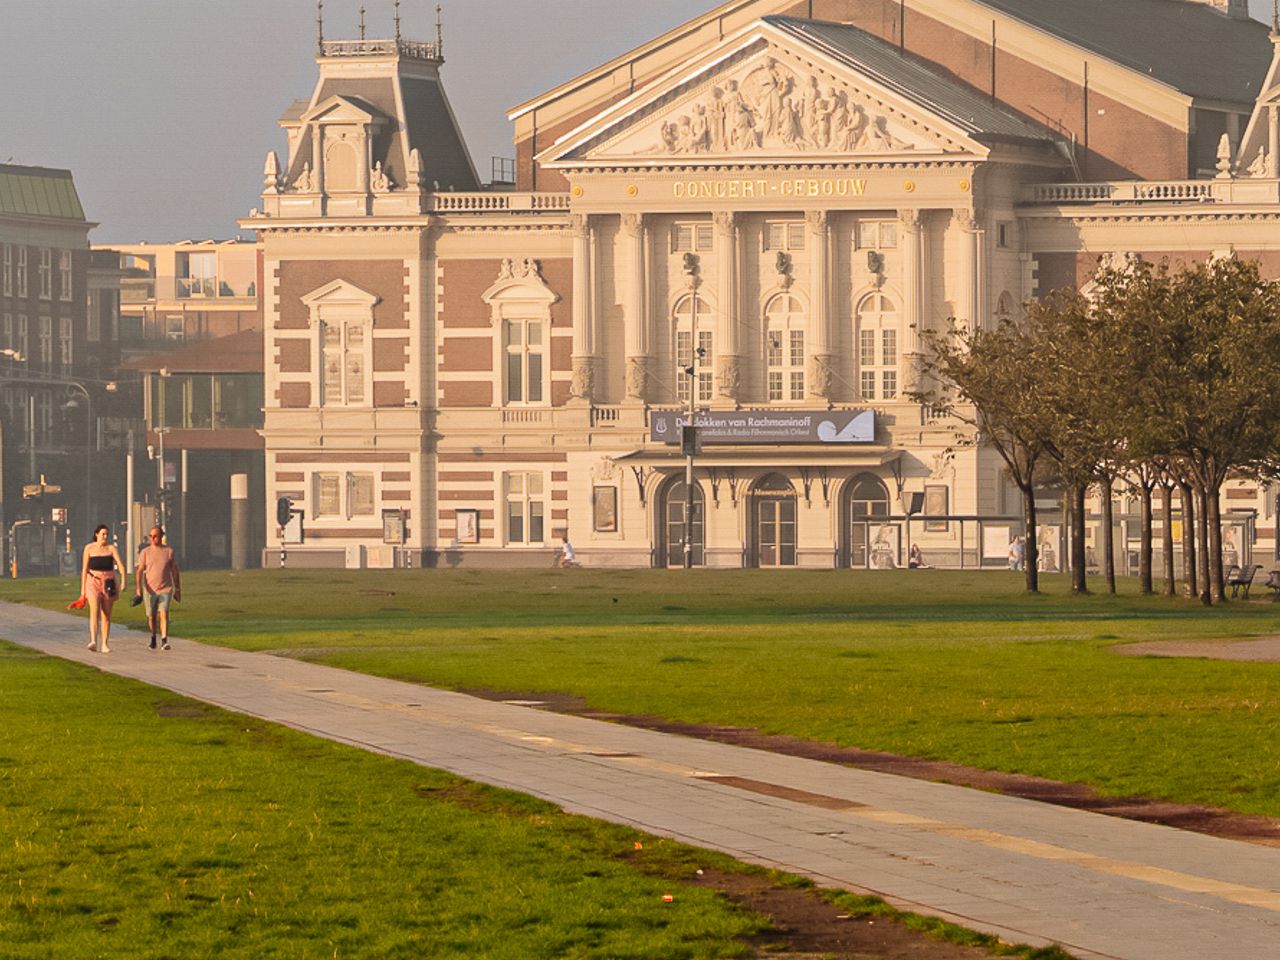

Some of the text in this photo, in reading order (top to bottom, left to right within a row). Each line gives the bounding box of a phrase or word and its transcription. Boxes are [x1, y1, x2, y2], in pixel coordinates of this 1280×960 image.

[672, 179, 868, 198] CONCERT-GEBOUW
[729, 419, 746, 427] van
[747, 416, 812, 427] Rachmaninoff
